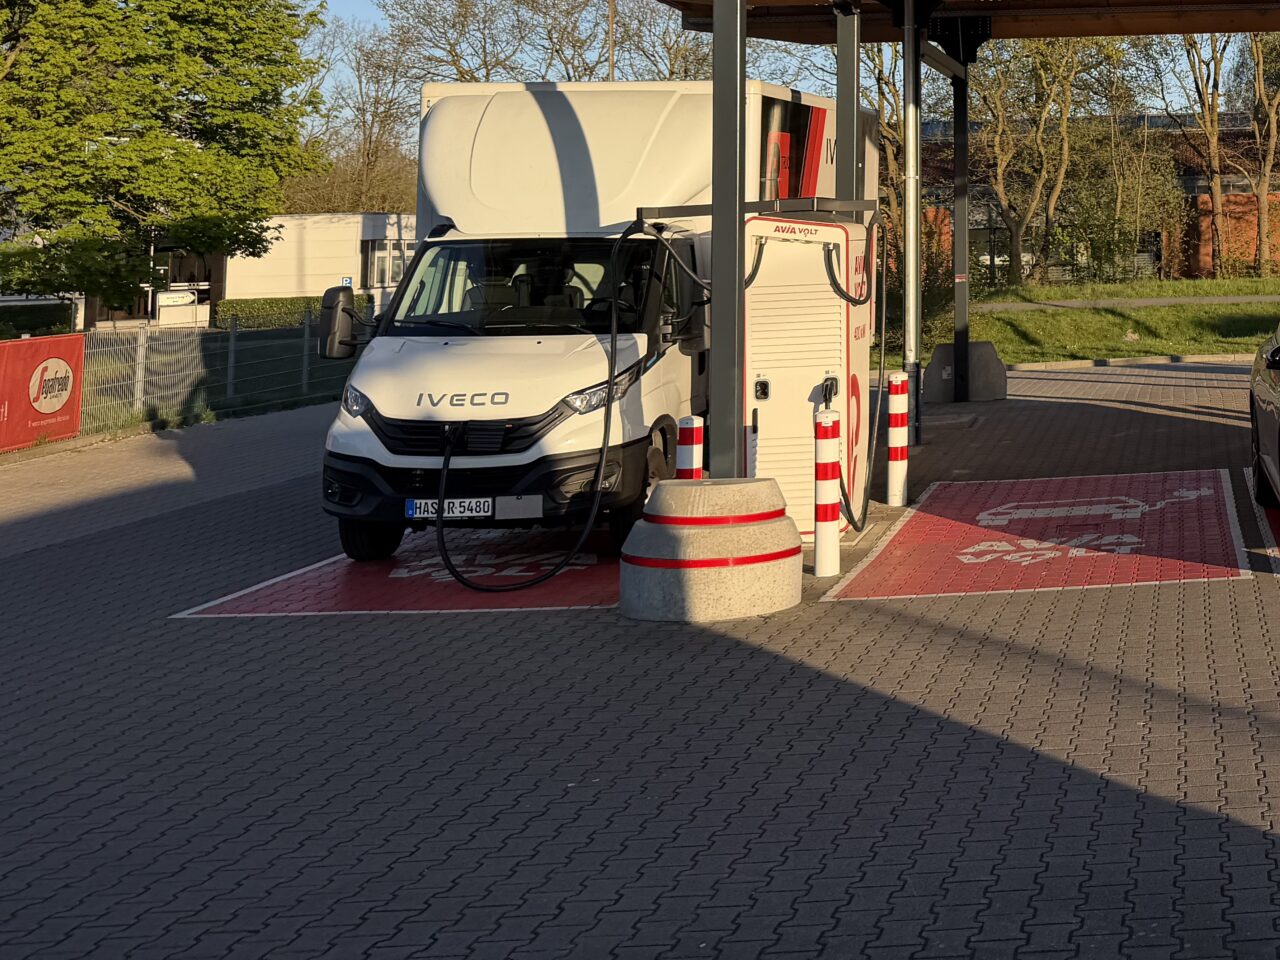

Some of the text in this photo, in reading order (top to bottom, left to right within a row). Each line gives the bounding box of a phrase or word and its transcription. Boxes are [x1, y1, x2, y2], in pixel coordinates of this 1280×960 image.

[797, 227, 819, 237] VOLT
[32, 365, 70, 404] Segafredo
[416, 392, 510, 407] IVECO
[414, 501, 439, 516] HAS
